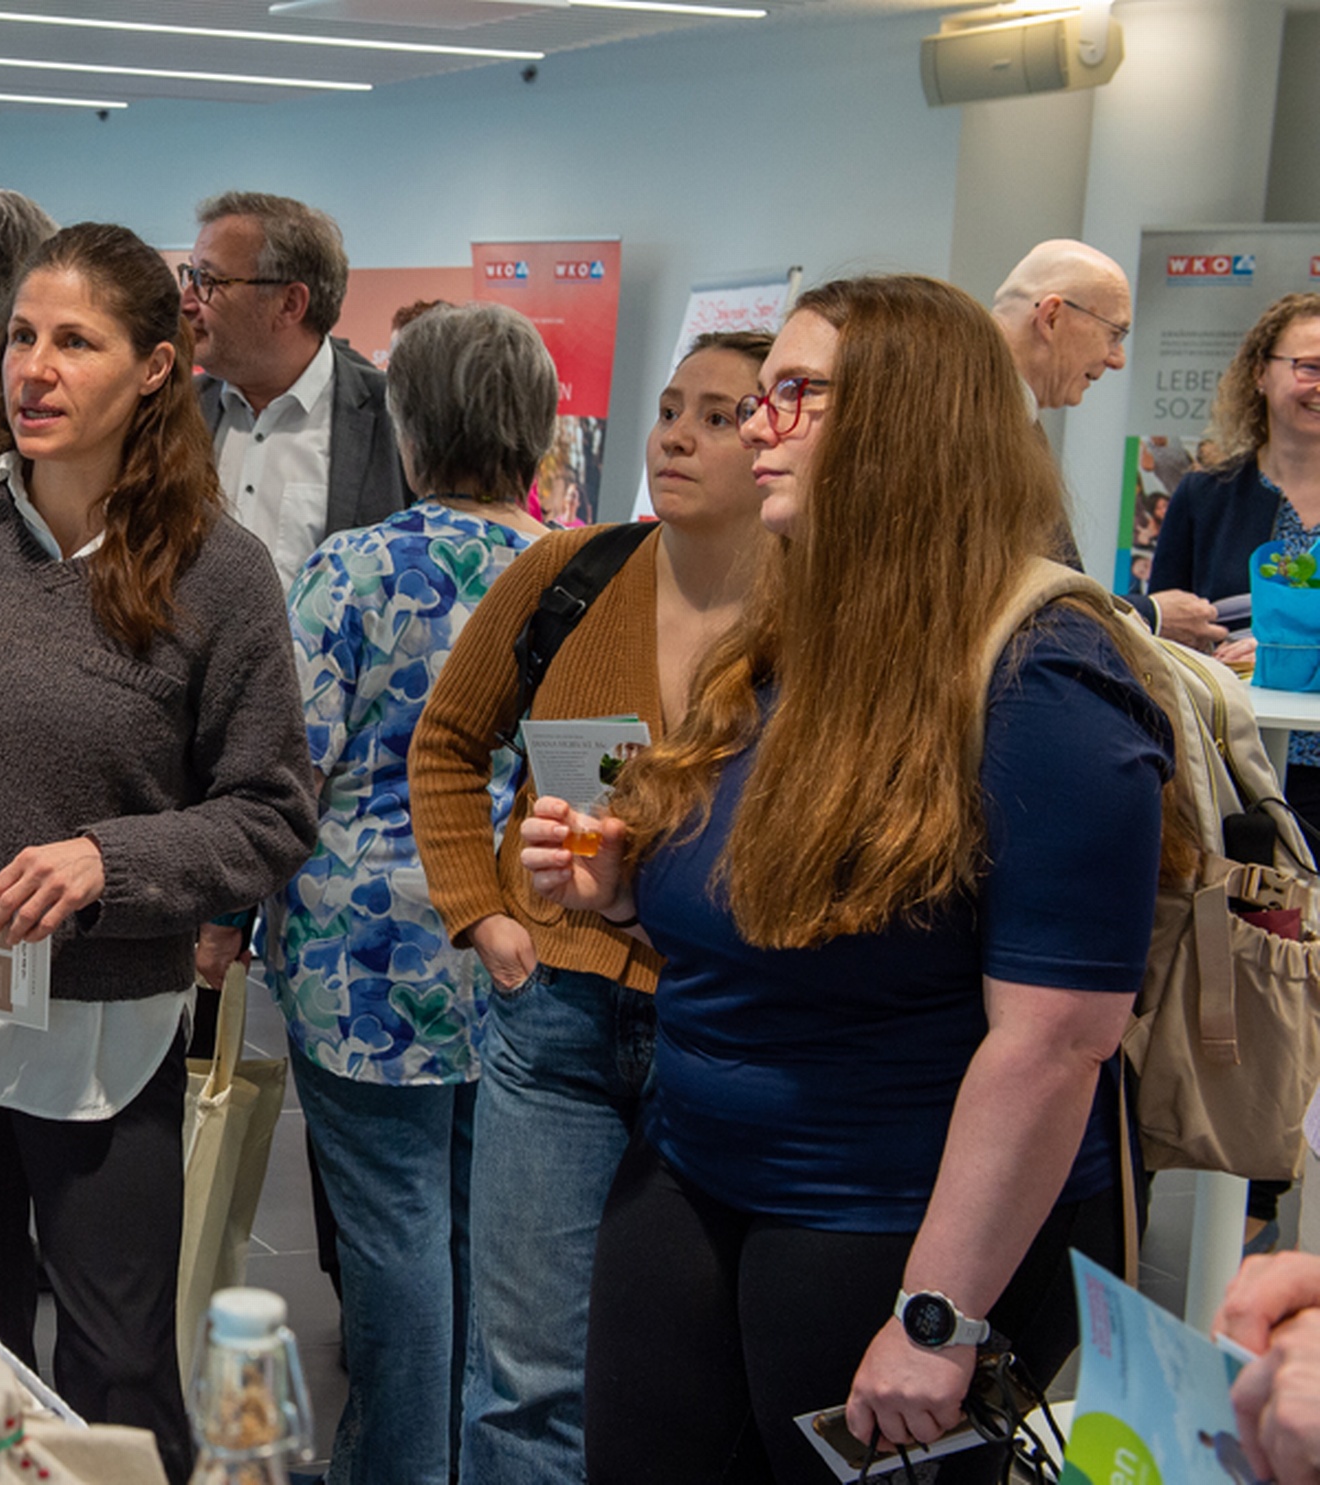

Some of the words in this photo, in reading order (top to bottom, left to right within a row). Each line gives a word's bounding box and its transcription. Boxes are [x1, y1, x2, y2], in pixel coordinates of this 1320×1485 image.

[485, 263, 516, 277] WKO
[554, 262, 590, 277] WKO
[1168, 257, 1231, 274] WKO
